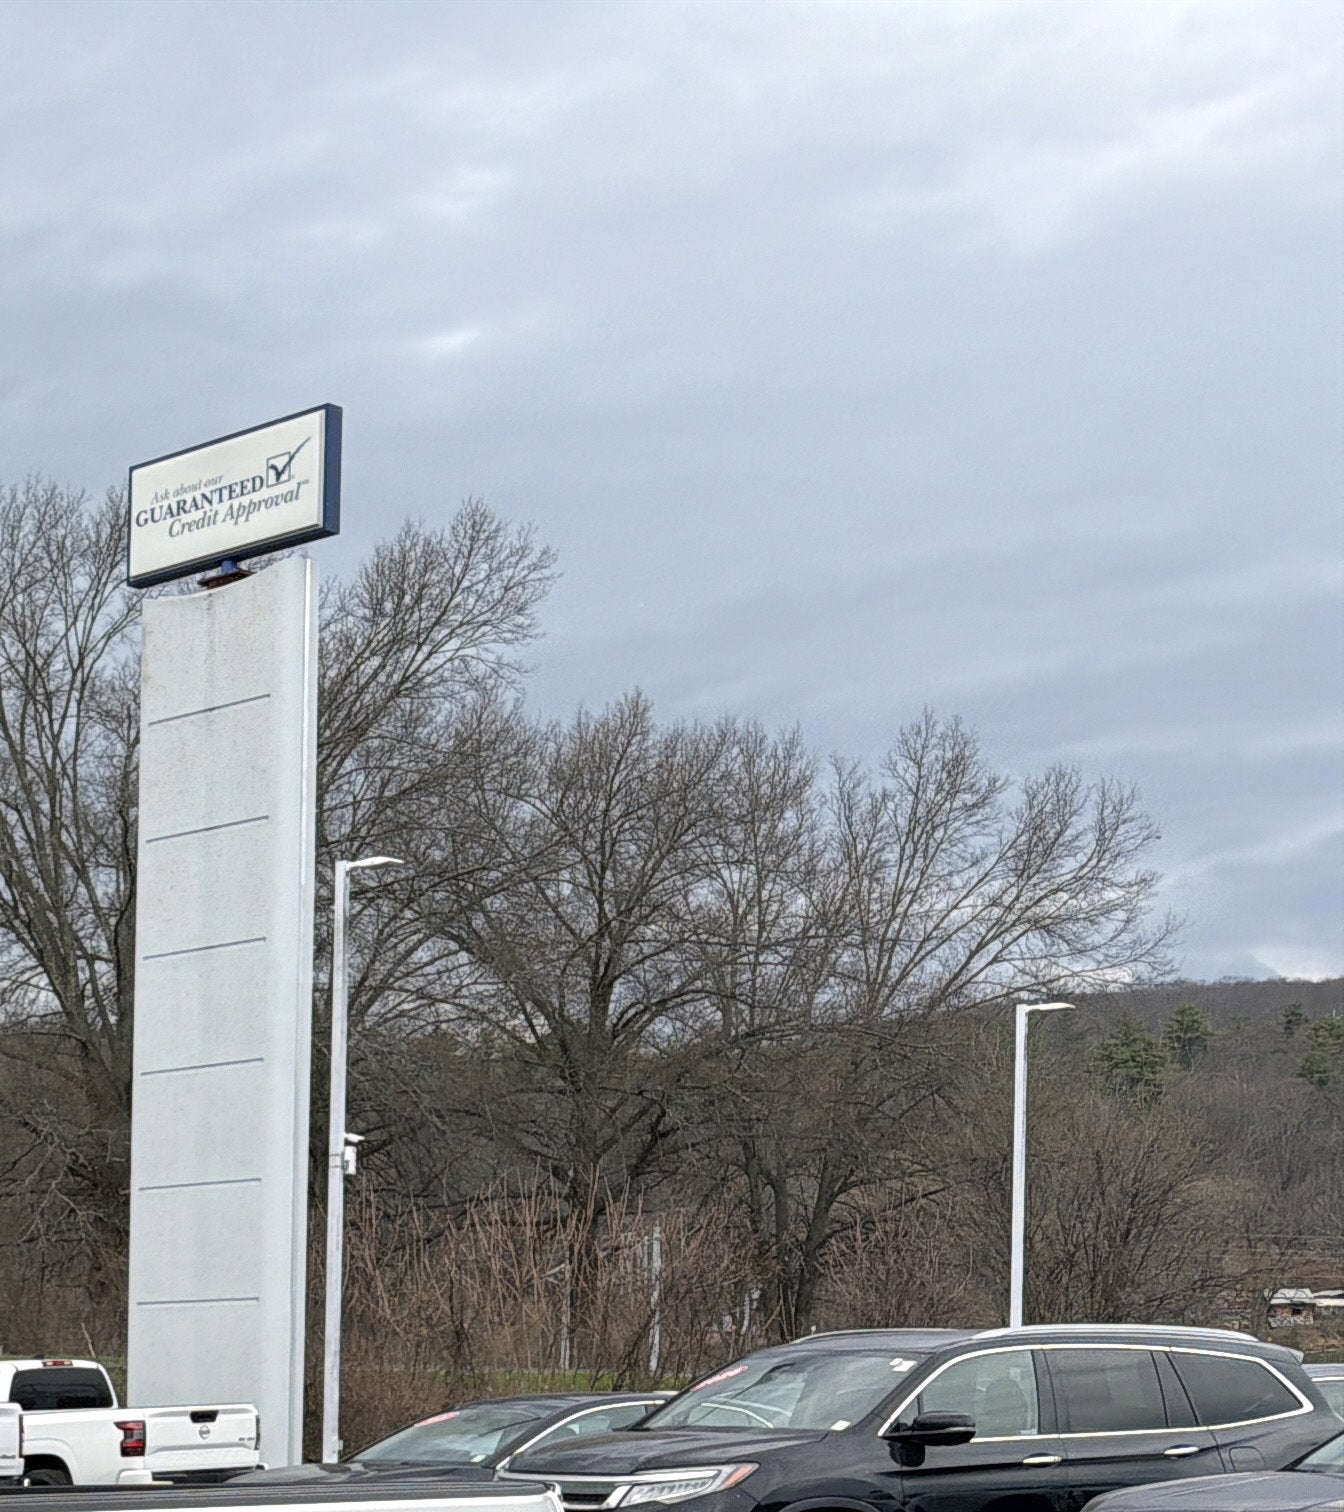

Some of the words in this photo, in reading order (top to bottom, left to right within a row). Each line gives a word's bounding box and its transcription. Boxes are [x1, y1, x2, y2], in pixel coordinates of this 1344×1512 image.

[135, 475, 264, 528] GUARANTEED
[150, 490, 171, 507] Ask
[173, 478, 203, 498] about
[203, 473, 224, 490] our
[168, 510, 221, 538] Credit
[222, 481, 301, 526] Approval
